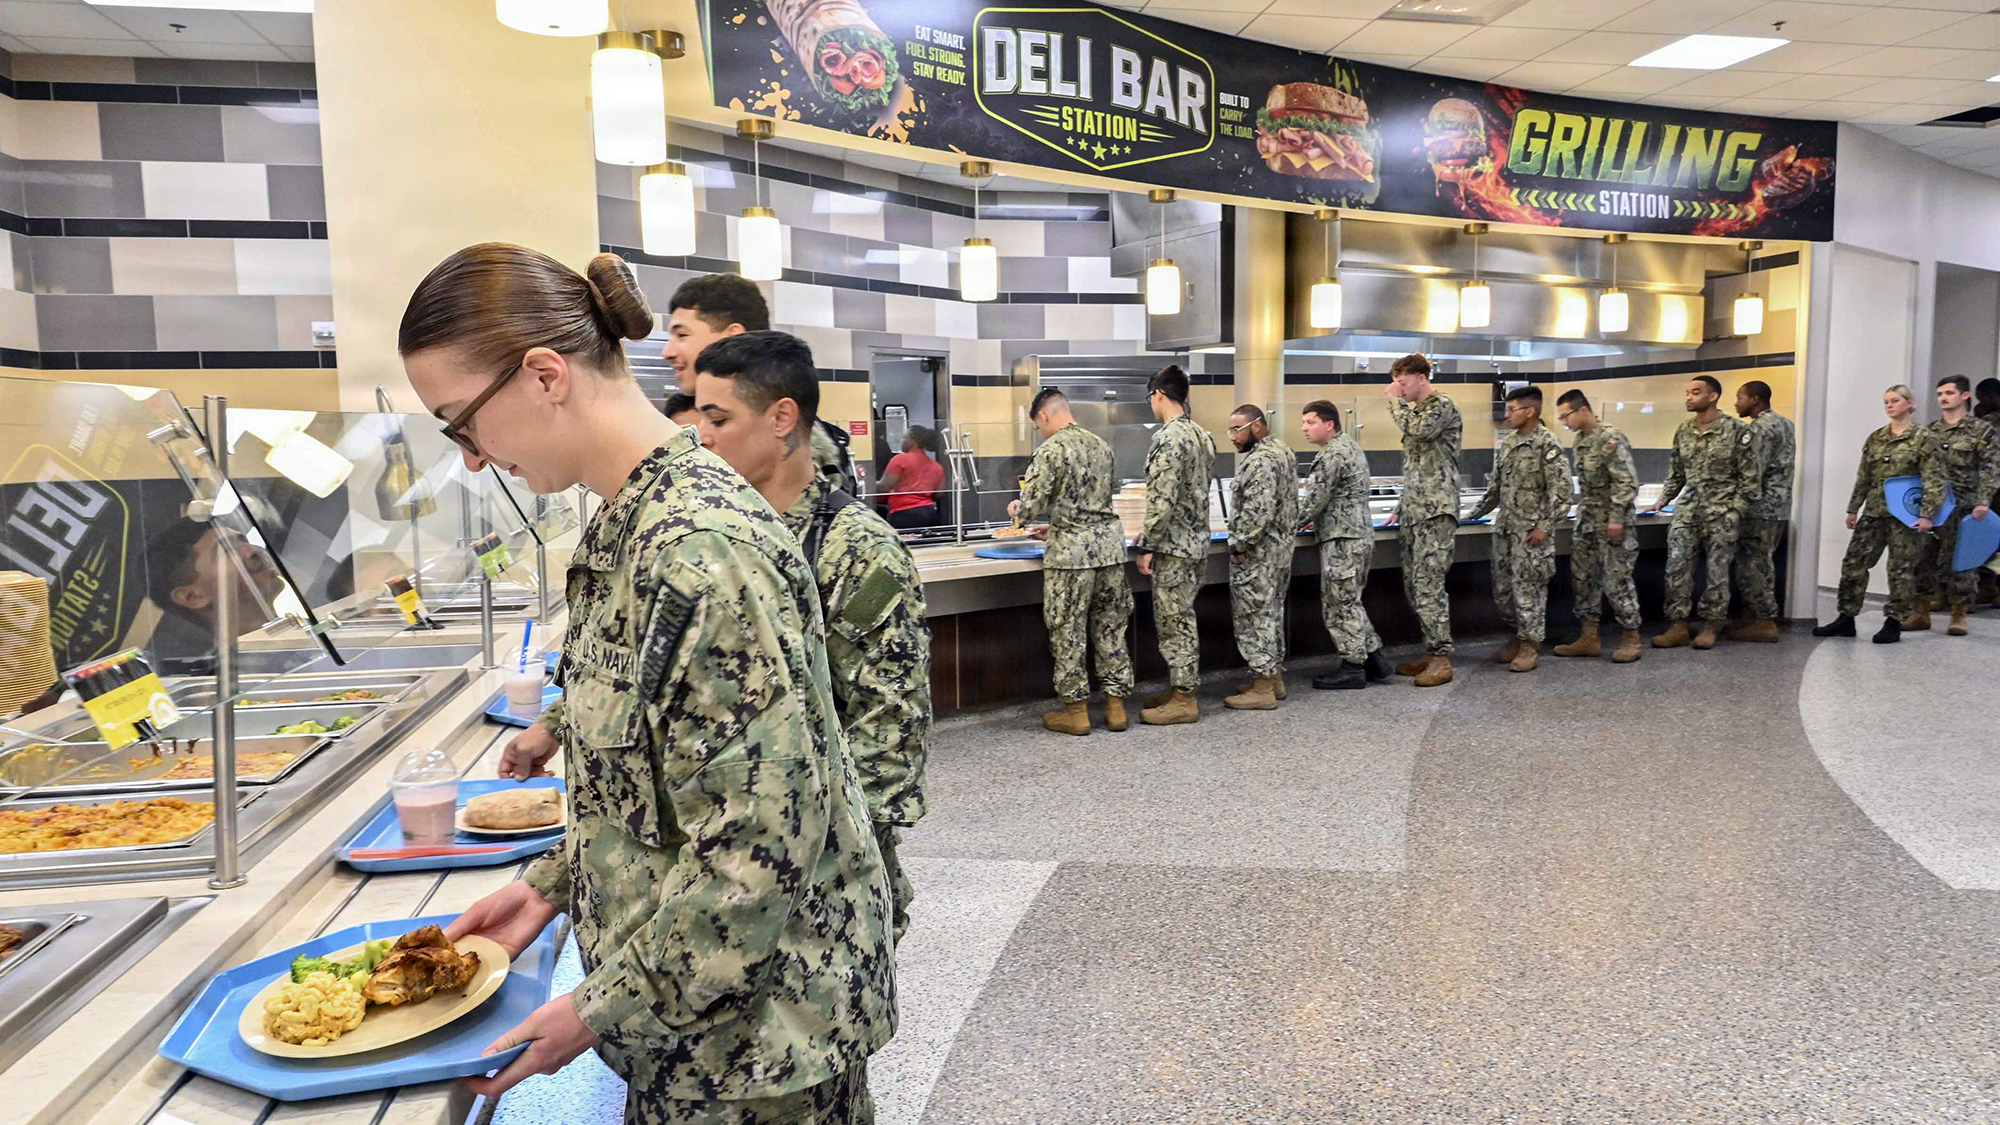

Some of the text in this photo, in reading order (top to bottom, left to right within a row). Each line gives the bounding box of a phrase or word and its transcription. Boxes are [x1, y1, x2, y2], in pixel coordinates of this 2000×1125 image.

[915, 25, 966, 50] EAT SMART.
[905, 40, 966, 68] FUEL STRONG.
[913, 61, 966, 86] STAY READY.
[982, 26, 1208, 135] DELI BAR
[1219, 92, 1250, 109] BUILT TO
[1062, 105, 1137, 142] STATION
[1219, 107, 1244, 123] CARRY
[1220, 122, 1255, 140] THE LOAD.
[1507, 108, 1763, 192] GRILLING
[1599, 190, 1670, 219] STATION
